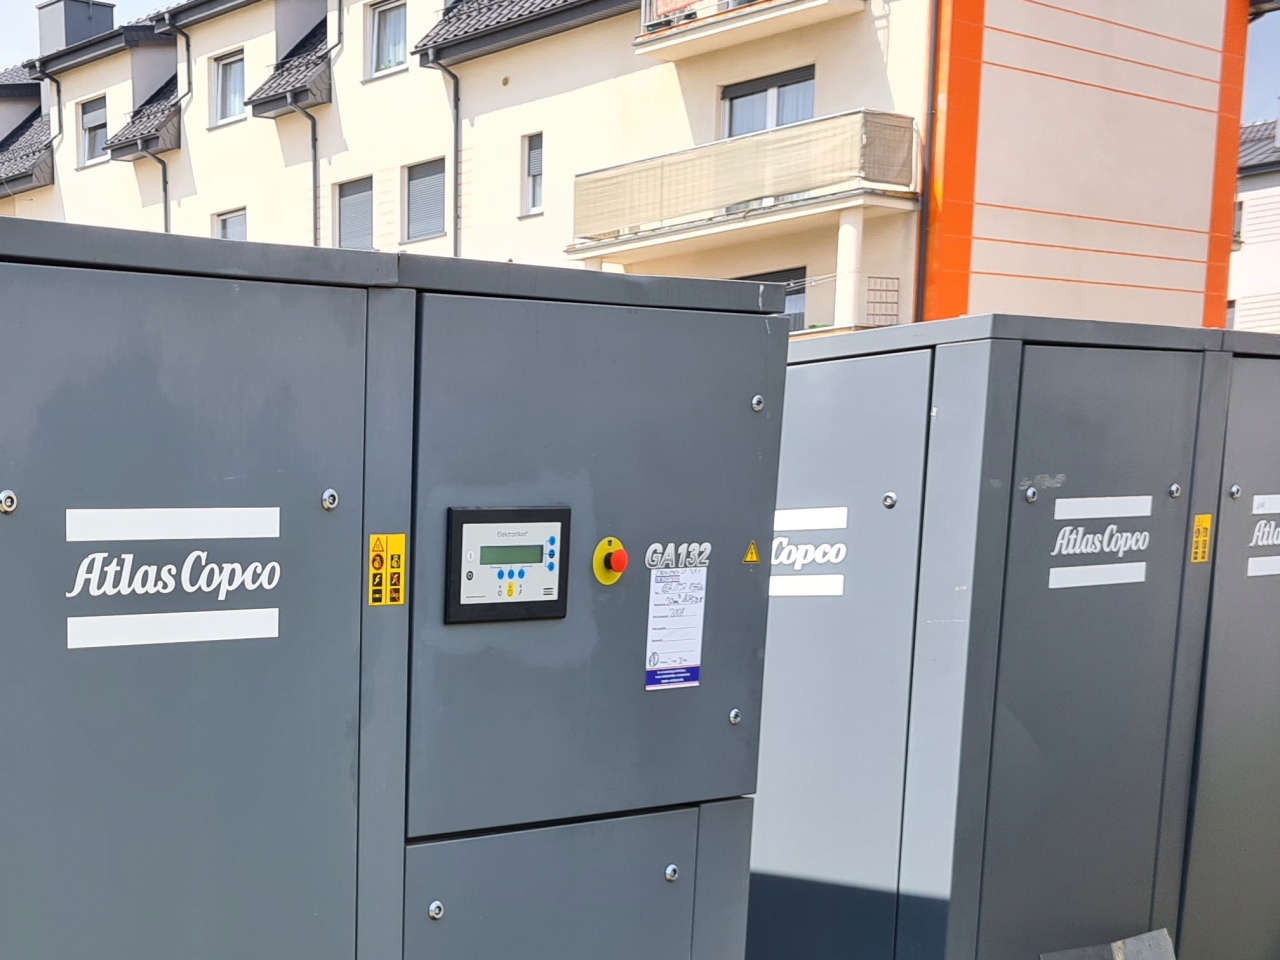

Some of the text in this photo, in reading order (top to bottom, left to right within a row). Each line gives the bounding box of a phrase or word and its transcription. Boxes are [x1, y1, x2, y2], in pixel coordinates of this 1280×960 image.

[645, 542, 712, 569] GA132
[770, 536, 847, 571] Copco
[1050, 524, 1150, 557] Atlas Copco
[65, 550, 281, 601] Atlas Copco
